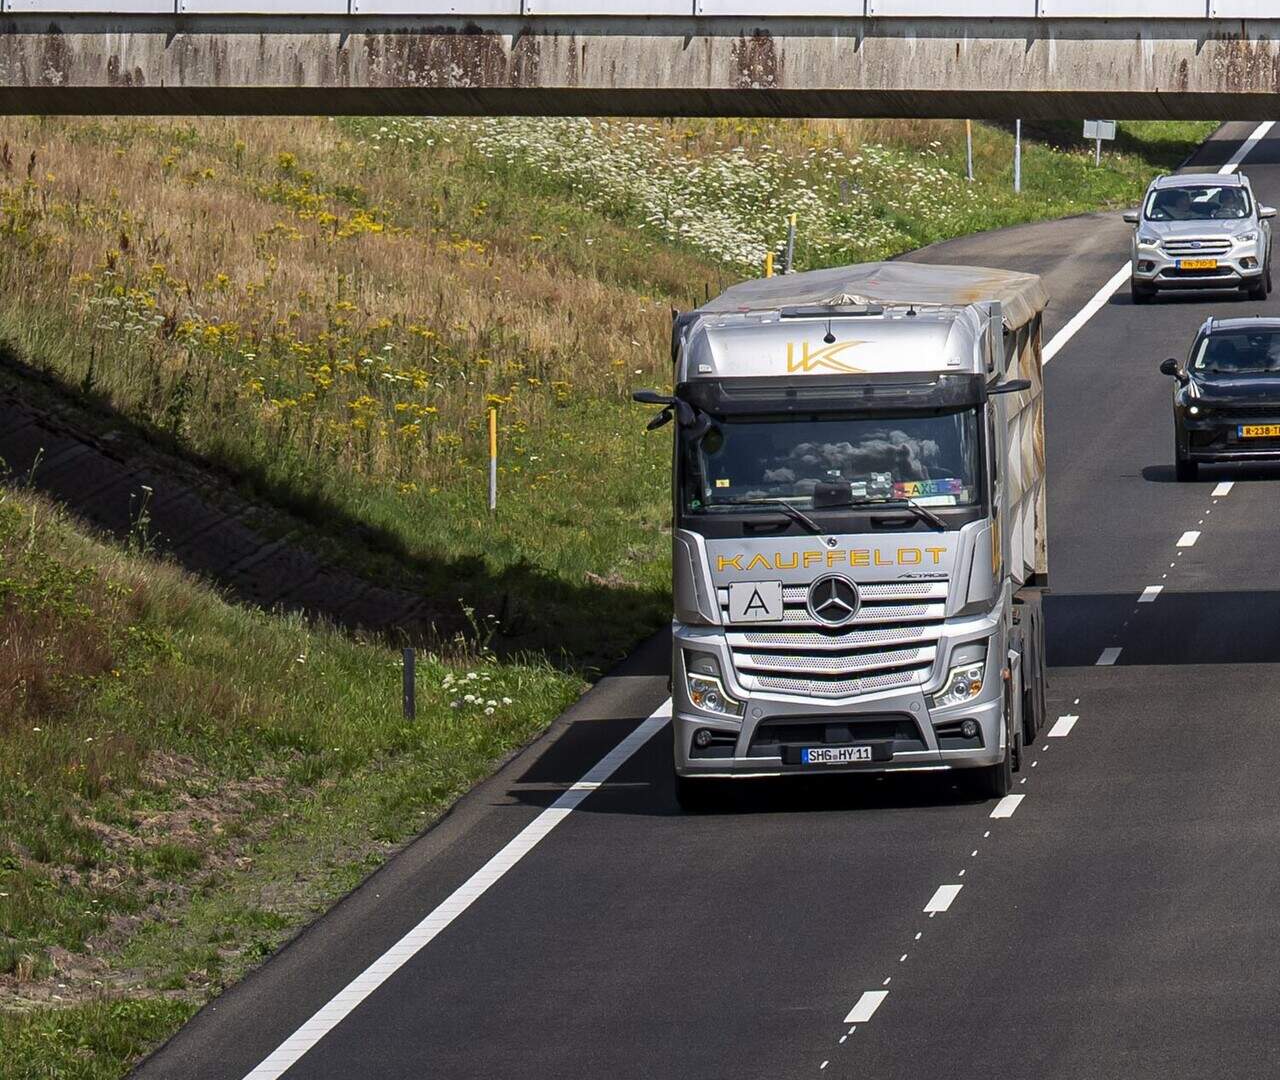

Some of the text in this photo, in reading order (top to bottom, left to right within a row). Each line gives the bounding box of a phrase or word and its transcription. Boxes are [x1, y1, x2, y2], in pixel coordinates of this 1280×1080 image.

[716, 546, 948, 572] KAUFFELDT
[742, 588, 771, 616] A
[809, 748, 871, 762] SHG HY 11
